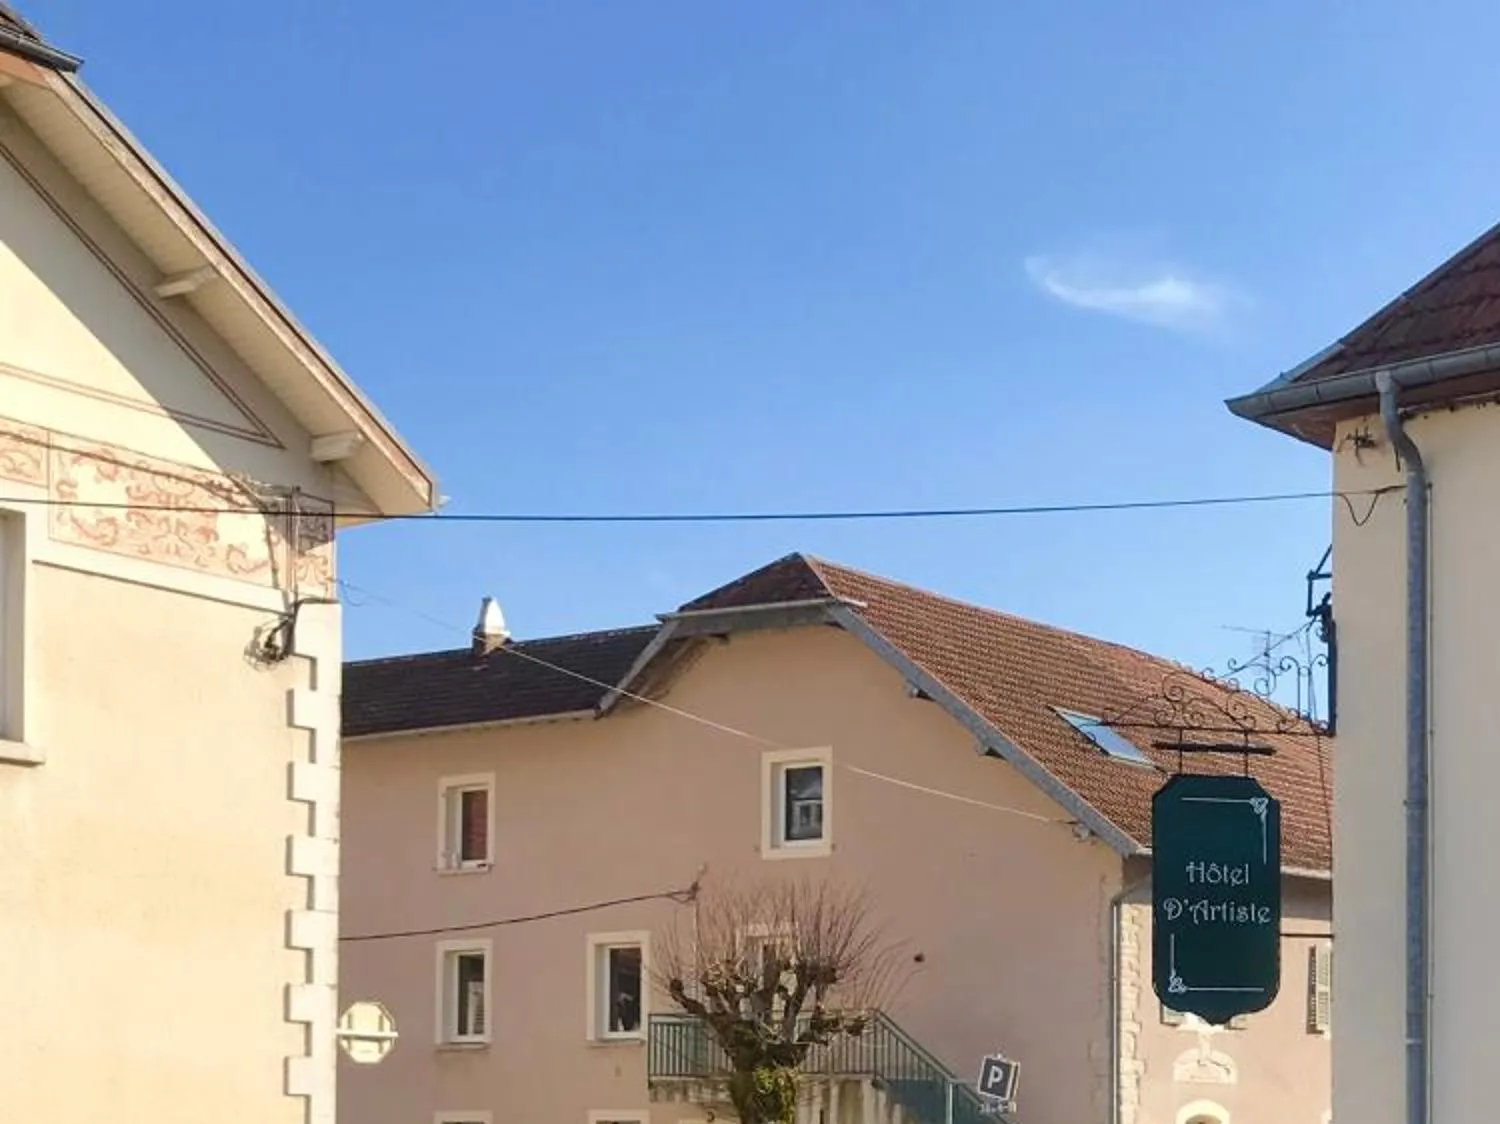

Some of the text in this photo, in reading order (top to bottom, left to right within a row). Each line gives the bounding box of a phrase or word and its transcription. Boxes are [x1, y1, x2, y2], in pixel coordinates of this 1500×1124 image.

[1186, 861, 1249, 886] Hôtel
[1163, 898, 1271, 924] D'Artiste
[987, 1065, 1003, 1089] P
